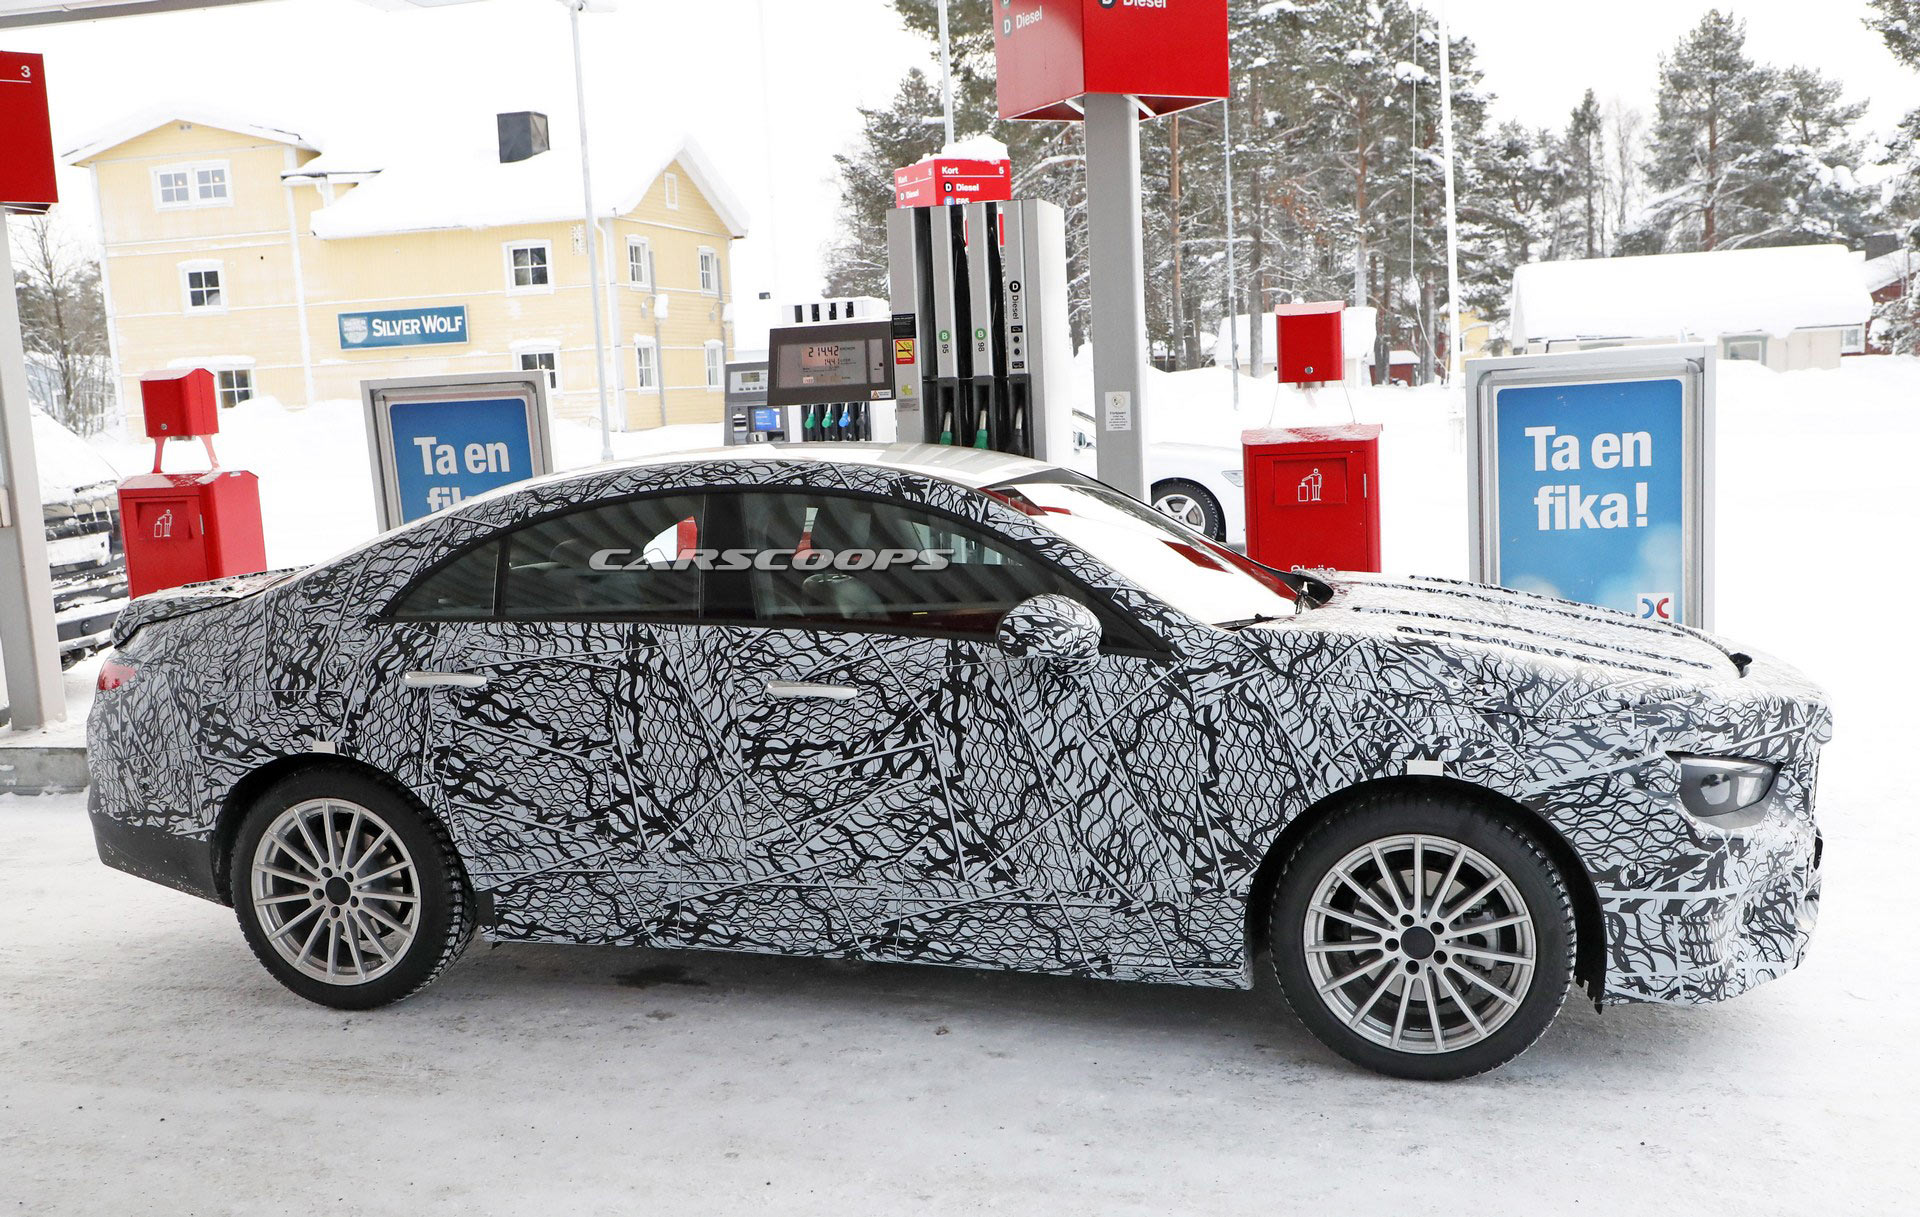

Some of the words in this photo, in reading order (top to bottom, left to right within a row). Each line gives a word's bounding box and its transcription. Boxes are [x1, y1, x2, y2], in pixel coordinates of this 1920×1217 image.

[1016, 5, 1043, 29] Diesel
[21, 65, 31, 78] 3
[956, 183, 979, 192] Diesel
[372, 318, 421, 337] SILVER
[421, 315, 463, 334] WOLF
[942, 343, 949, 354] 95
[977, 342, 985, 352] 98
[413, 436, 458, 475] Ta
[464, 442, 511, 474] en
[1524, 425, 1580, 472] Ta
[1591, 431, 1652, 470] en
